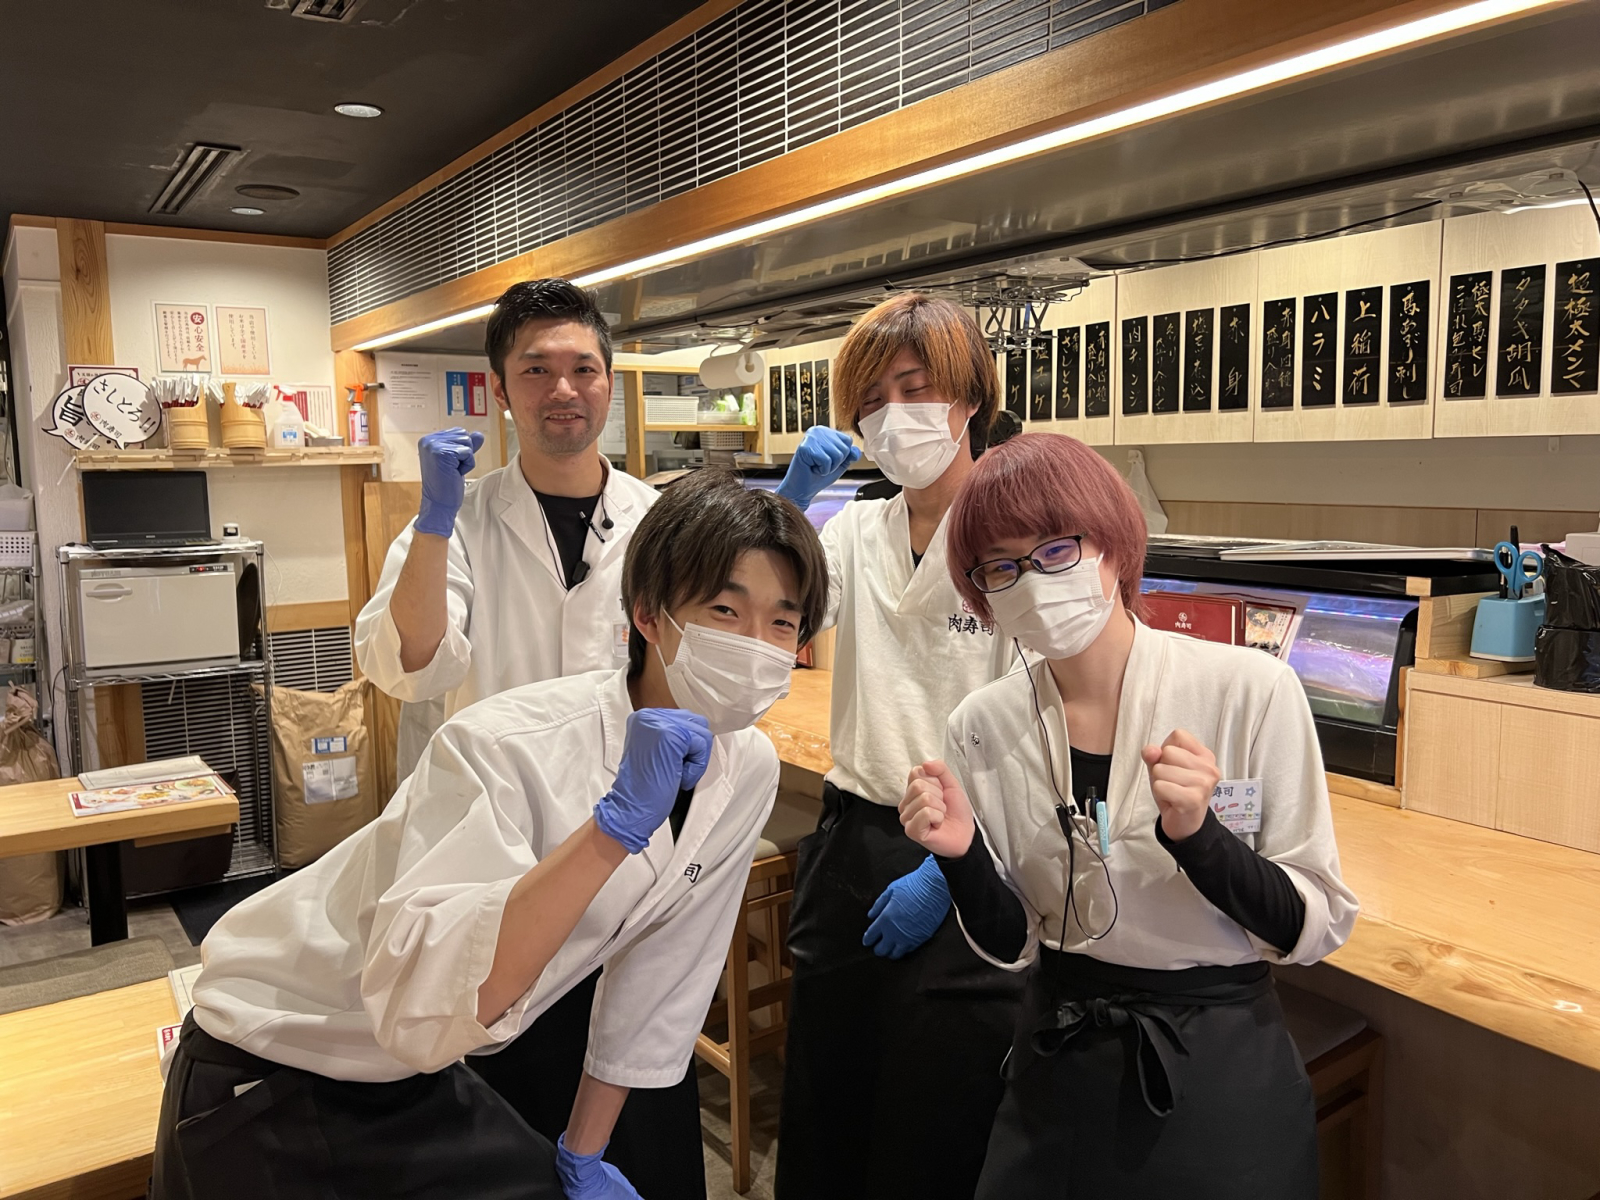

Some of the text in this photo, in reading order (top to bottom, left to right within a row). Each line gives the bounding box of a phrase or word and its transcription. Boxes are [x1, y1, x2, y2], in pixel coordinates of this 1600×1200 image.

[191, 313, 205, 352] 安心安全
[1224, 316, 1245, 397] 赤身
[1310, 304, 1330, 391] ハラミ
[1347, 300, 1377, 396] 上稲荷
[1560, 271, 1594, 389] 超極太メンマ
